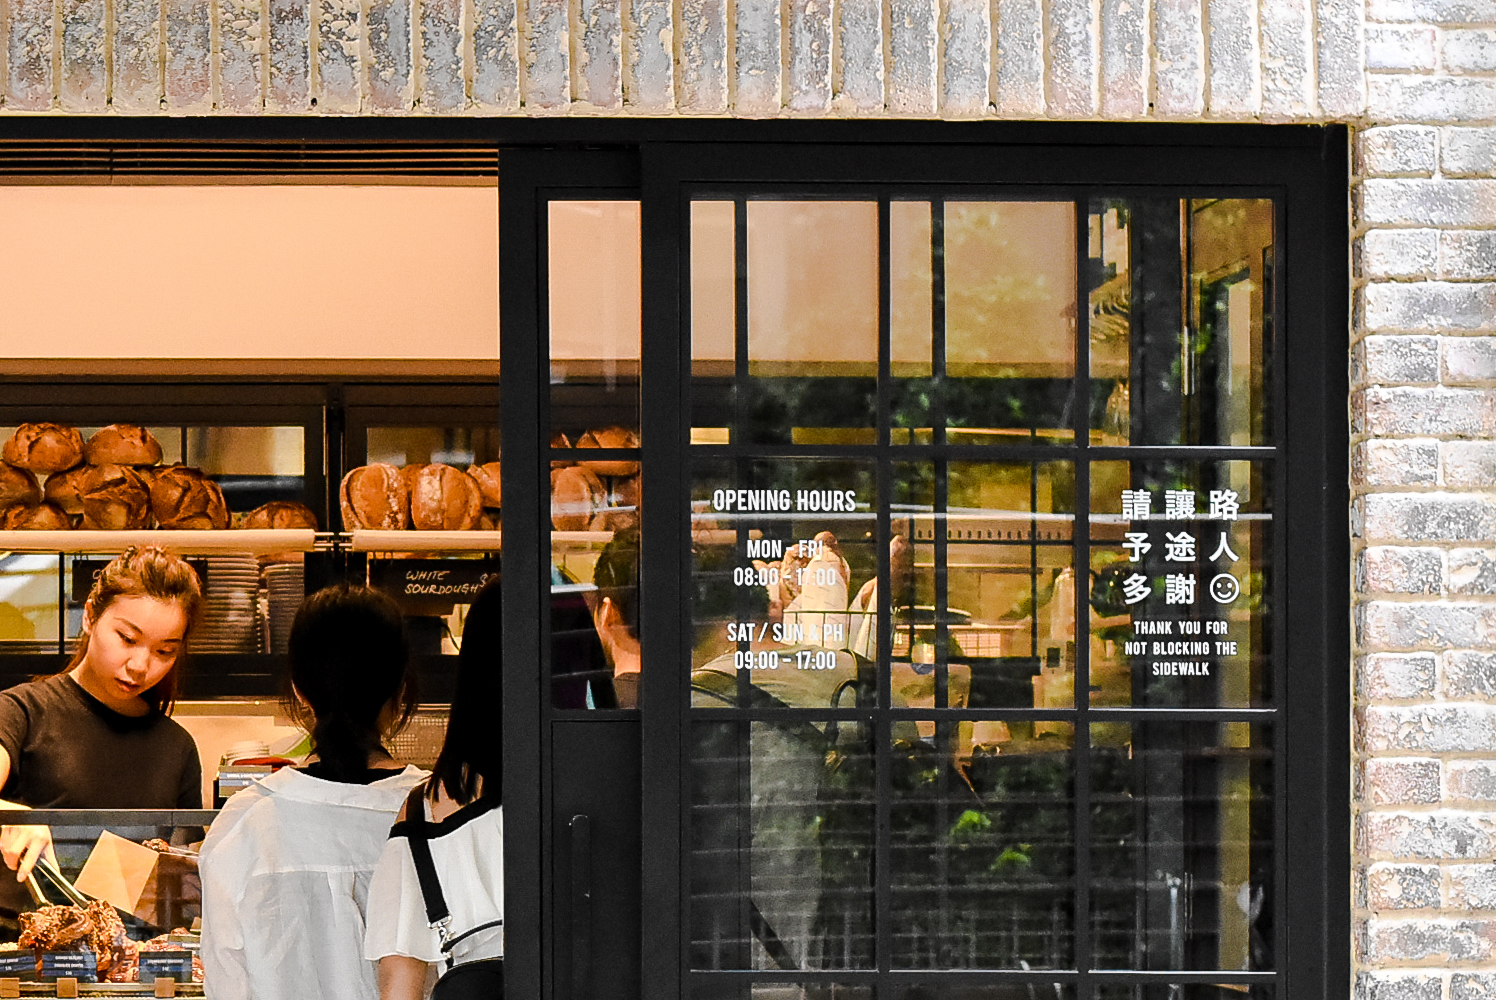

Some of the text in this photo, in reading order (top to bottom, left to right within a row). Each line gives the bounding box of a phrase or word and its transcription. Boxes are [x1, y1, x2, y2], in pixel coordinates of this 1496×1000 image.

[713, 490, 856, 512] OPENING HOURS
[1121, 489, 1240, 521] 請讓路
[747, 540, 782, 559] MON
[798, 540, 823, 559] FRI
[1122, 531, 1240, 563] 予途人
[405, 570, 450, 581] WHITE
[733, 567, 779, 586] 08:00
[797, 567, 837, 586] 17:00
[404, 583, 478, 595] SOURDOUGH
[1122, 572, 1197, 605] 多謝
[727, 623, 756, 642] SAT
[772, 624, 804, 642] SUN
[823, 623, 844, 641] PH
[1134, 621, 1229, 635] THANK YOU FOR
[1124, 641, 1238, 656] NOT BLOCKING THE
[734, 651, 779, 670] 09:00
[795, 651, 837, 670] 17:00
[1152, 662, 1210, 676] SIDEWALK
